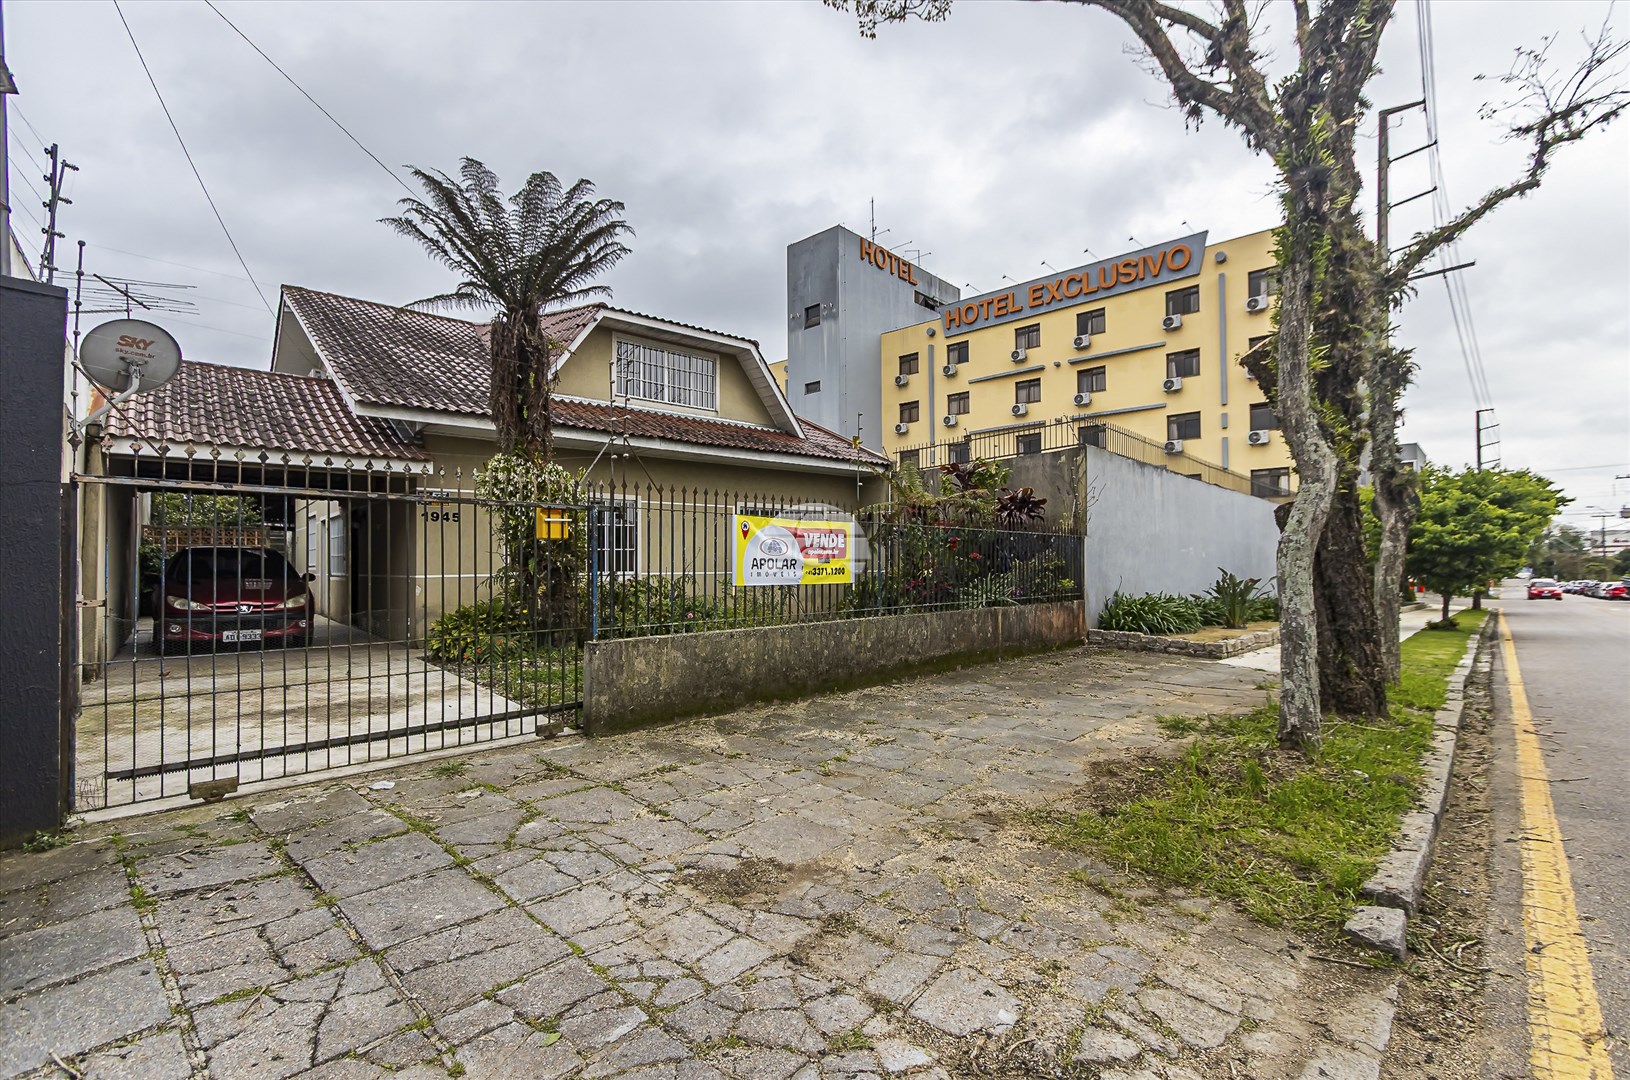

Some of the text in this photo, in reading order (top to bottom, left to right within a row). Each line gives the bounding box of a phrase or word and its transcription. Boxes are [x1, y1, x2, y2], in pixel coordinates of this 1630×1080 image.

[860, 236, 919, 285] HOTEL
[945, 243, 1192, 329] HOTEL EXCLUSIVO
[116, 334, 156, 351] SKY
[114, 347, 156, 359] sky.com.br
[420, 511, 460, 522] 1945
[803, 532, 845, 548] VENDE
[751, 557, 798, 570] APOLAR
